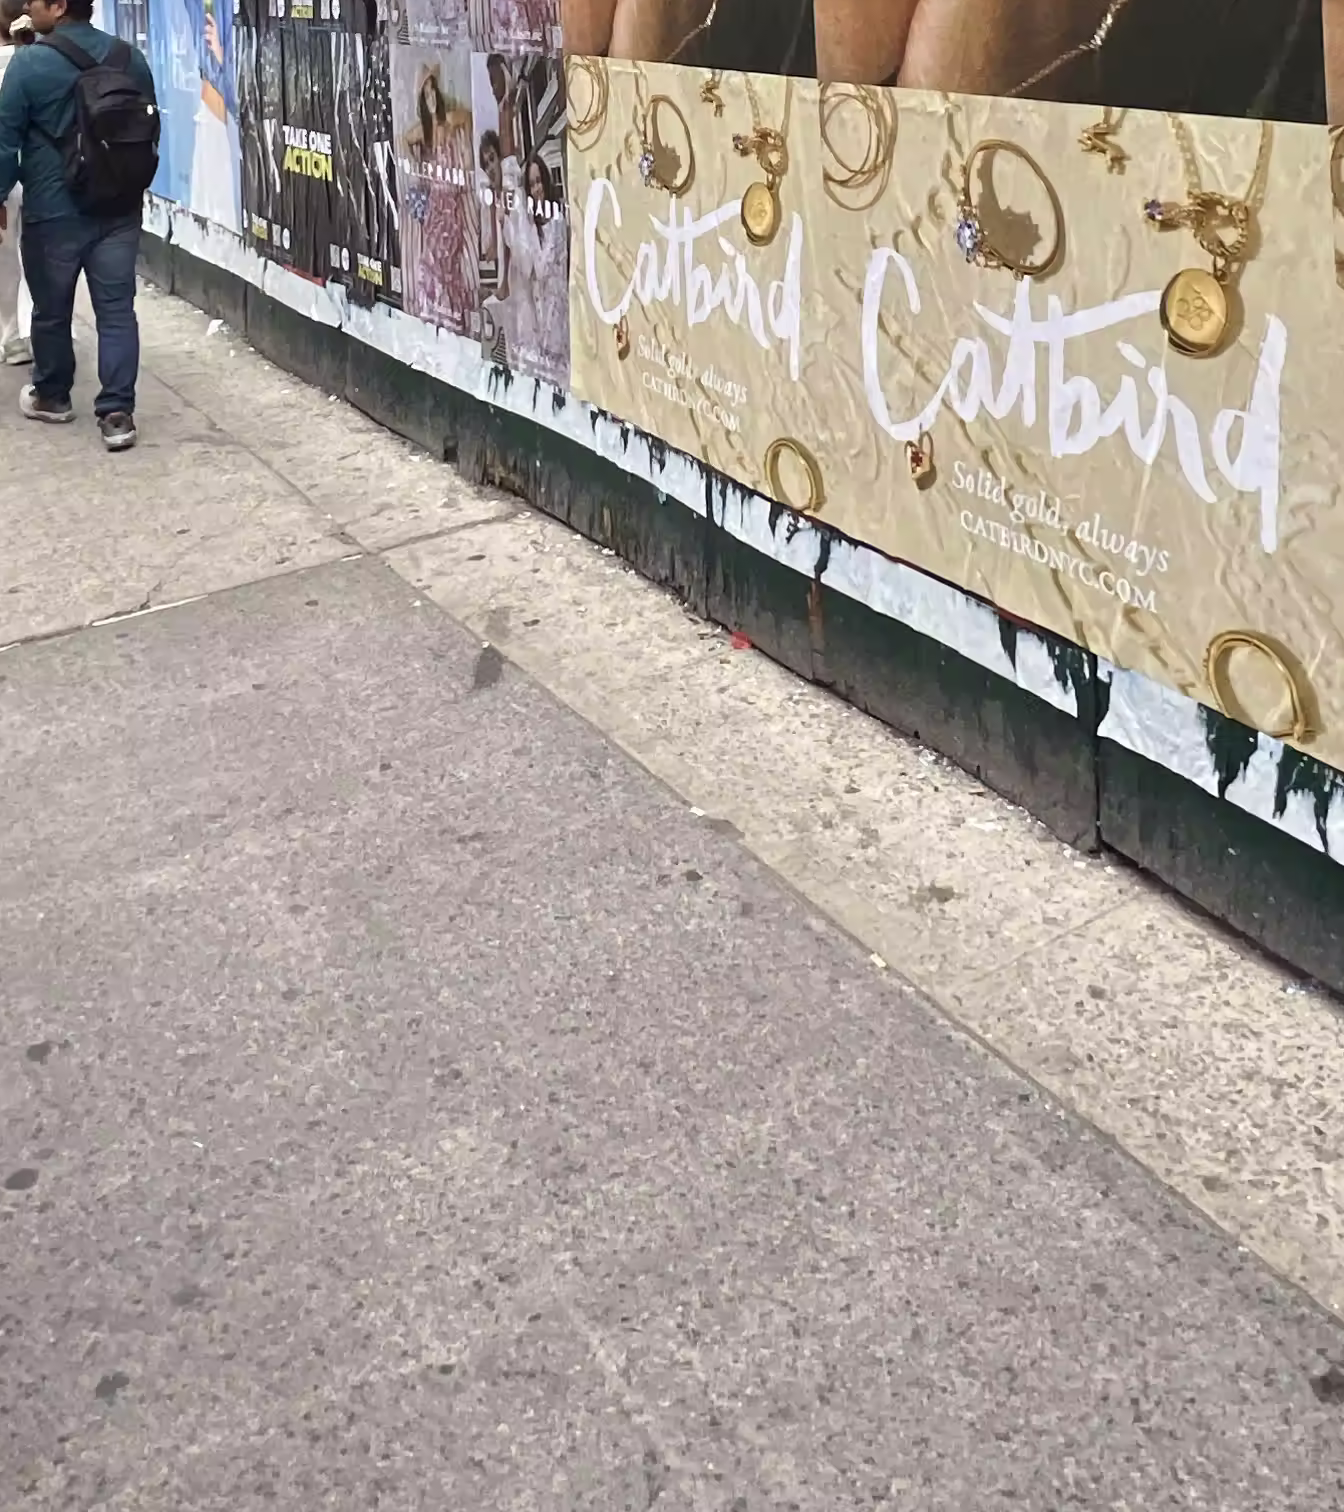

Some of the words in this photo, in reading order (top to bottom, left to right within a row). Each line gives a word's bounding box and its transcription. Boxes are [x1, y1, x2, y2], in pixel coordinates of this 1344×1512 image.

[283, 125, 307, 148] TAKE
[308, 131, 331, 155] ONE
[283, 146, 333, 182] ACTION
[584, 177, 802, 381] Catbird
[638, 334, 666, 366] Solid
[701, 364, 748, 407] always
[862, 246, 1287, 554] Catbird
[952, 460, 1007, 506] Solid
[1009, 490, 1069, 536] gold,
[1075, 513, 1170, 576] always
[960, 510, 1158, 613] CATBIRDNYC.COM
